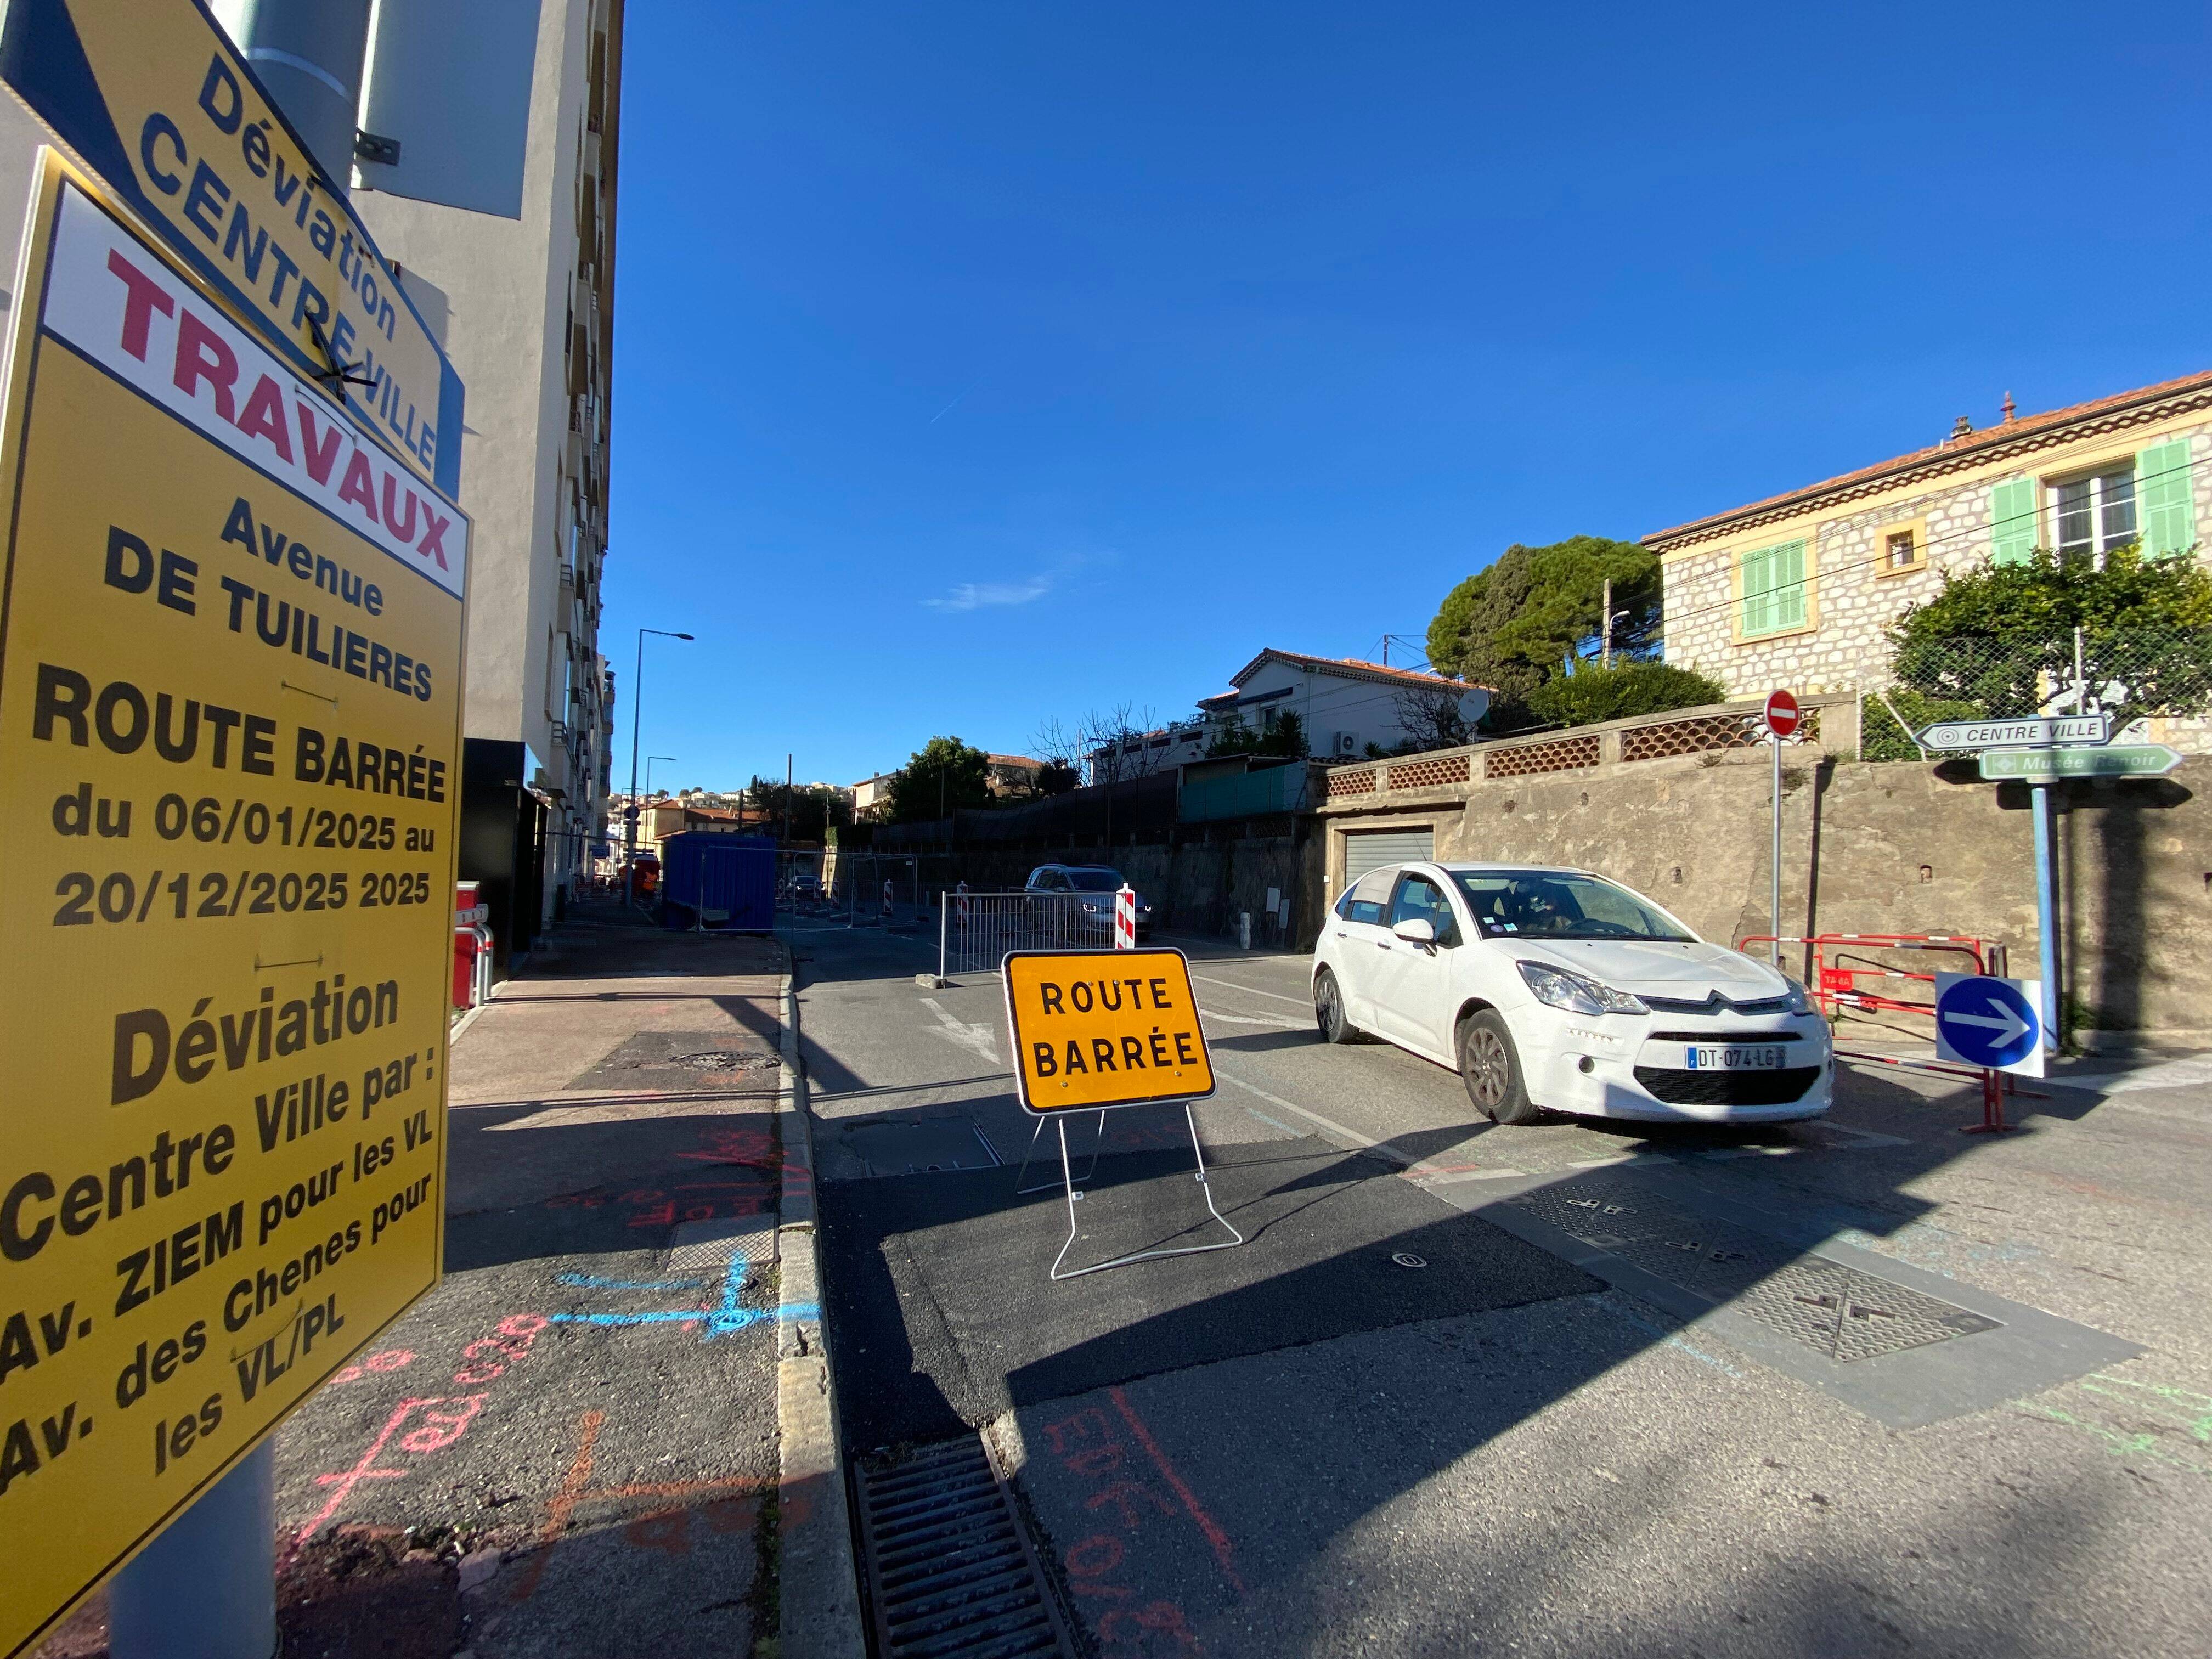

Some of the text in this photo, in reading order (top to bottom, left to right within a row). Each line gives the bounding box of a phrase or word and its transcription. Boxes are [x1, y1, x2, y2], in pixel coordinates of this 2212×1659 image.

[198, 52, 396, 342] Déviation
[140, 112, 436, 472] CENTRE VILLE
[107, 247, 450, 572] TRAVAUX
[105, 524, 432, 702] DE TUILIERES
[221, 497, 383, 617] Avenue
[33, 663, 445, 803] ROUTE BARRÉE
[1967, 722, 2097, 742] CENTRE VILLE
[2023, 754, 2084, 770] Musée
[52, 782, 435, 852] du 06/01/2025 au
[53, 870, 430, 927] 20/12/2025 2025
[111, 974, 398, 1106] Déviation
[1033, 1027, 1198, 1078] BARRÉE
[1040, 978, 1172, 1015] ROUTE
[1, 1124, 235, 1262] Centre
[255, 1074, 348, 1153] Ville
[362, 1051, 417, 1121] par
[0, 1109, 433, 1384] Av. ZIEM pour les VL
[0, 1173, 431, 1496] Av. des Chenes pour
[156, 1392, 223, 1475] les
[237, 1294, 345, 1404] VL/PL
